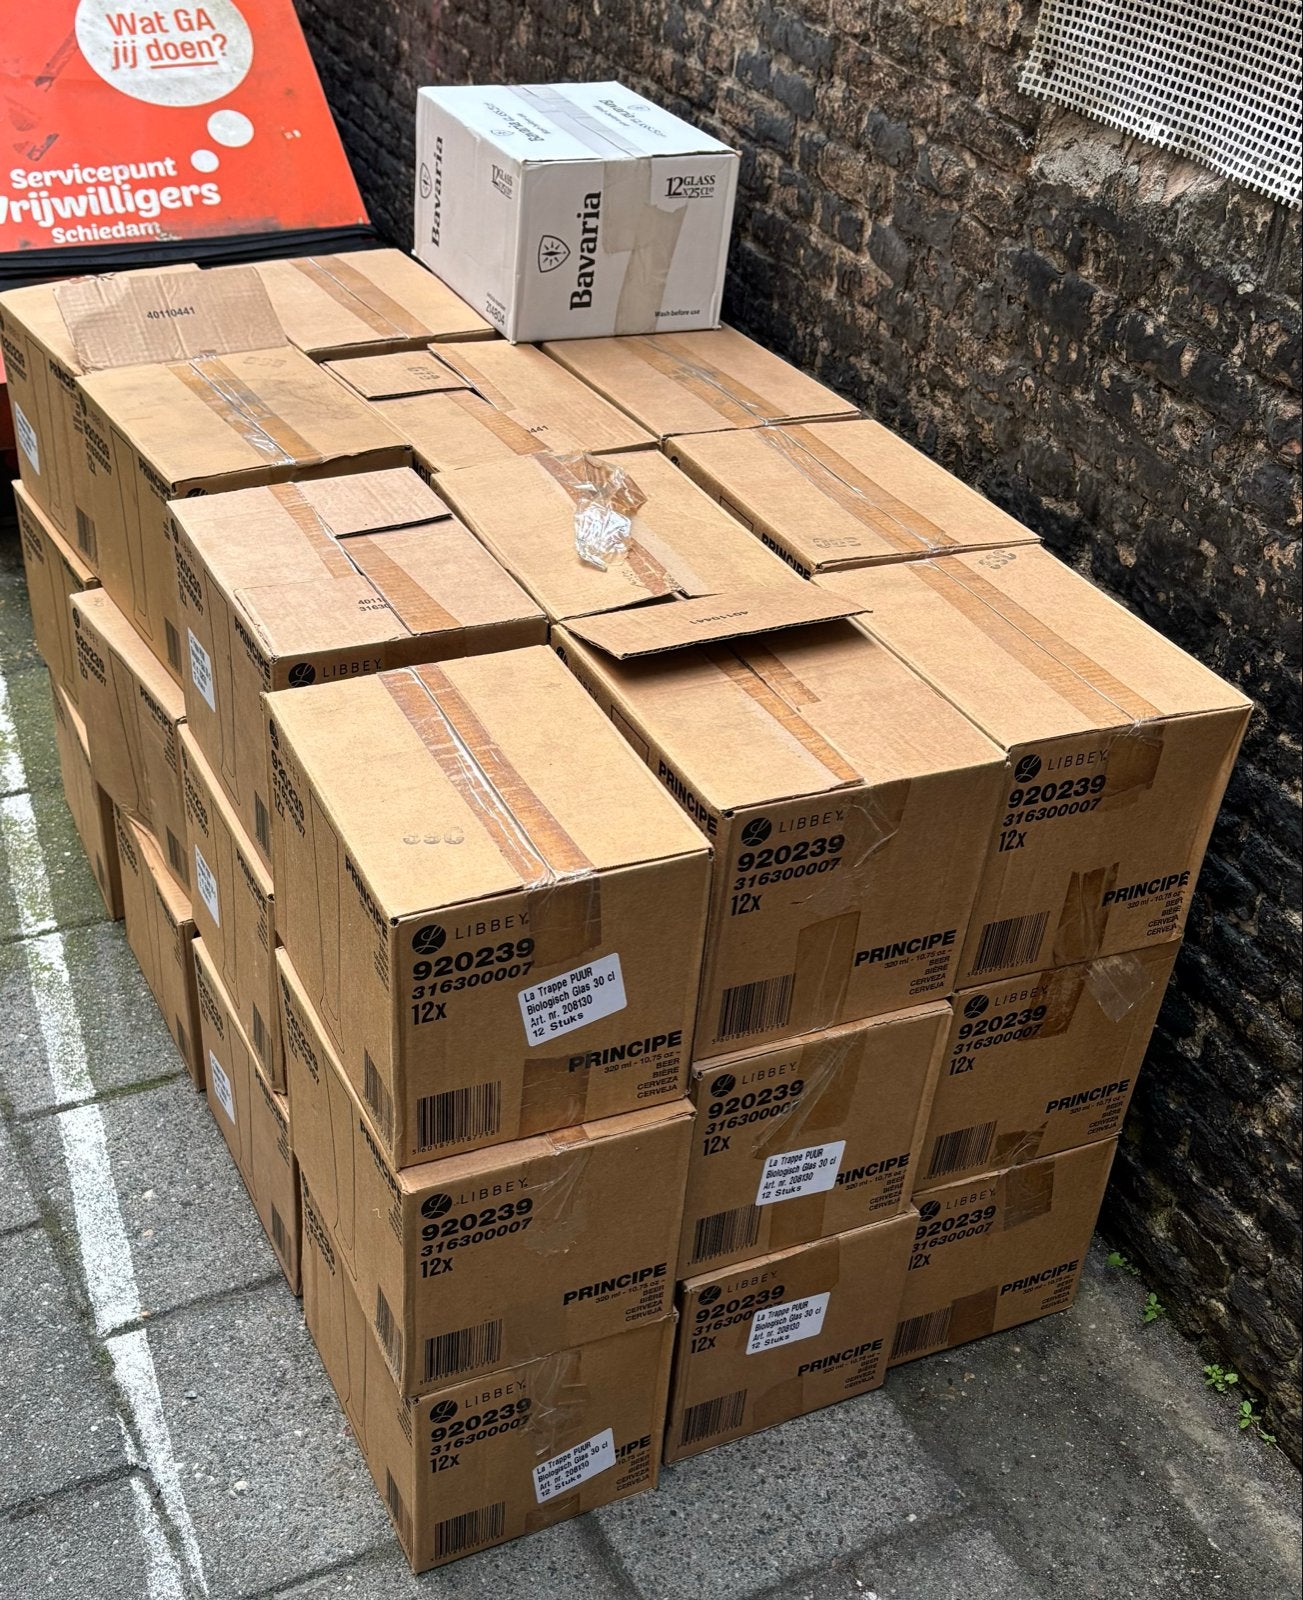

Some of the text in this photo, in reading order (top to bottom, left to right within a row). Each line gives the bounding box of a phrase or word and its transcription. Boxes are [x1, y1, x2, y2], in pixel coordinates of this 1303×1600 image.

[106, 7, 216, 37] Wat GA
[112, 33, 228, 69] jij doen?
[10, 156, 177, 190] Servicepunt
[432, 136, 442, 247] Bavaria
[51, 222, 160, 244] Schiedam
[569, 192, 601, 310] Bavaria
[146, 306, 196, 320] 40110441
[234, 616, 270, 679] PRINCIPE
[323, 658, 380, 678] LIBBEY
[1047, 750, 1106, 771] LIBBEY
[658, 760, 718, 836] PRINCIPE
[1008, 774, 1107, 808] 920239
[779, 810, 843, 834] LIBBEY
[1002, 797, 1102, 827] 316300007
[737, 834, 845, 872] 920239
[999, 829, 1027, 852] 12x
[733, 857, 842, 890] 316300007
[1102, 870, 1191, 907] PRINCIPE
[731, 893, 762, 916] 12x
[455, 912, 528, 940] LIBBEY
[412, 937, 535, 981] 920239
[854, 929, 957, 967] PRINCIPE
[411, 961, 534, 999] 316300007
[524, 967, 593, 1003] La Trappe PUUR
[527, 971, 615, 1015] Biologisch Glas 30 cl
[909, 981, 944, 995] CERVEJA
[910, 973, 946, 987] CERVEZA
[994, 984, 1048, 1007] LIBBEY
[411, 1001, 447, 1026] 12x
[531, 994, 593, 1028] Art. nr. 208130
[533, 1012, 584, 1037] 12 Stuks
[958, 1005, 1047, 1040] 920239
[568, 1030, 682, 1073] PRINCIPE
[953, 1023, 1043, 1055] 316300007
[604, 1064, 619, 1074] 320
[656, 1057, 680, 1069] BEER
[741, 1061, 797, 1085] LIBBEY
[950, 1056, 975, 1076] 12x
[636, 1076, 678, 1090] CERVEZA
[636, 1085, 677, 1099] CERVEJA
[1045, 1079, 1130, 1114] PRINCIPE
[708, 1079, 804, 1119] 920239
[703, 1136, 731, 1156] 12x
[769, 1148, 824, 1167] La Trappe PUUR
[766, 1156, 837, 1179] Biologisch Glas 30 cl
[789, 1172, 814, 1185] 208130
[835, 1152, 911, 1185] RINCIPE
[460, 1178, 526, 1205] LIBBEY
[762, 1186, 802, 1199] 12 Stuks
[946, 1188, 996, 1210] LIBBEY
[421, 1198, 533, 1241] 920239
[915, 1205, 996, 1240] 920239
[420, 1216, 533, 1257] 316300007
[912, 1222, 994, 1253] 316300007
[420, 1257, 454, 1278] 12x
[727, 1270, 778, 1293] LIBBEY
[1000, 1259, 1079, 1297] PRINCIPE
[562, 1262, 668, 1306] PRINCIPE
[696, 1285, 785, 1324] 920239
[690, 1336, 716, 1354] 12x
[797, 1338, 884, 1376] PRINCIPE
[465, 1381, 523, 1409] LIBBEY
[430, 1398, 532, 1444] 920239
[430, 1414, 532, 1457] 316300007
[429, 1454, 460, 1474] 12x
[537, 1441, 591, 1474] La Trappe PUUR
[538, 1441, 608, 1482] Biologisch Glas 30 cl
[565, 1460, 589, 1477] 208130
[541, 1474, 582, 1497] 12 Stuks
